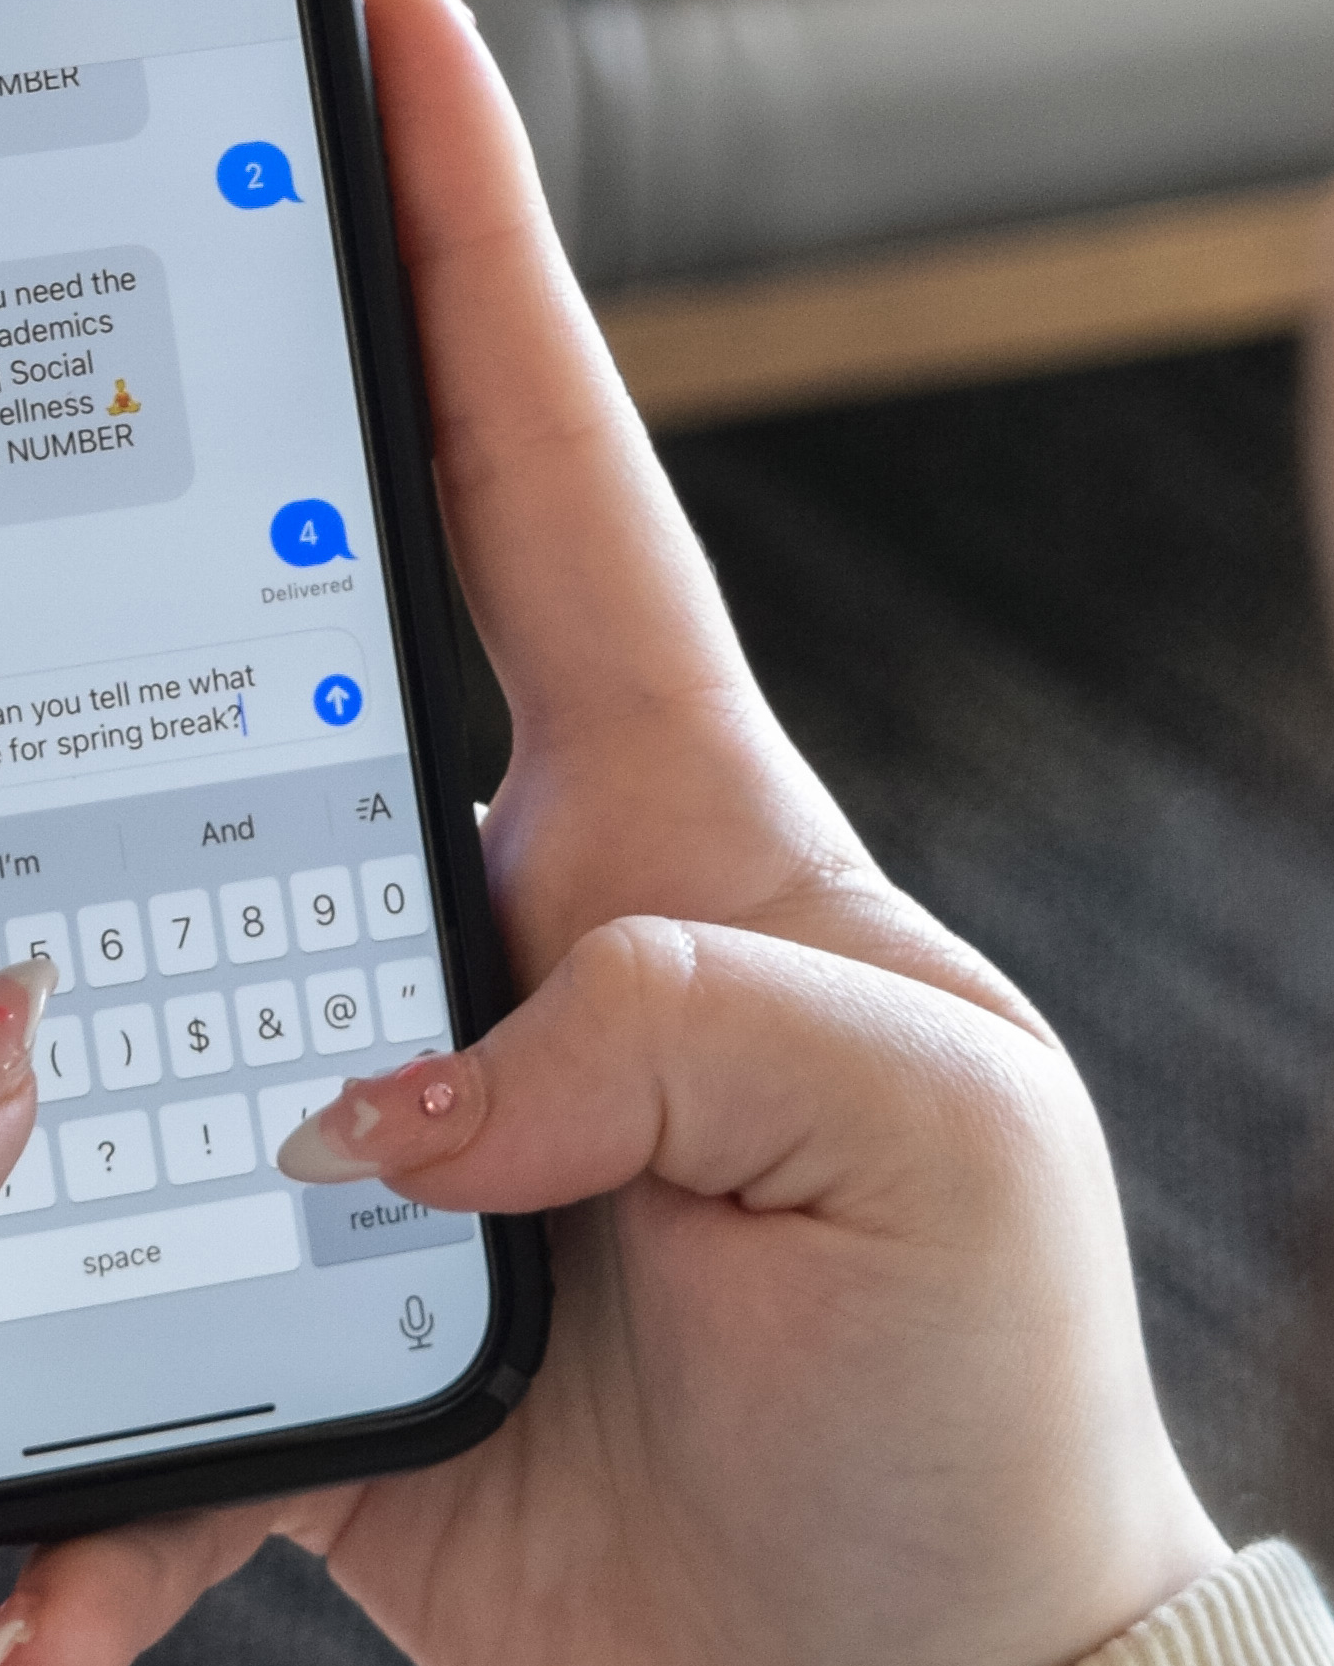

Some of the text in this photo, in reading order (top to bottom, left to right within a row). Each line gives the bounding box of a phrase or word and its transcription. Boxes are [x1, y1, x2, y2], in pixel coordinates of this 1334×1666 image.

[245, 163, 264, 190] 2
[15, 273, 83, 306] need
[91, 269, 136, 295] the
[10, 350, 94, 385] Social
[7, 424, 134, 464] NUMBER
[299, 520, 318, 546] 4
[262, 576, 353, 603] Delivered
[31, 696, 81, 726] you
[89, 681, 130, 710] tell
[139, 680, 180, 703] me
[188, 665, 255, 695] what
[9, 737, 47, 763] for
[57, 724, 143, 759] spring
[150, 704, 242, 740] break?
[202, 814, 255, 846] And
[101, 929, 123, 961] 6
[172, 917, 190, 949] 7
[242, 905, 265, 938] 8
[313, 894, 335, 926] 9
[383, 883, 405, 915] 0
[50, 1041, 62, 1077] (
[121, 1030, 132, 1066] )
[187, 1017, 210, 1053] $
[259, 1008, 284, 1040] &
[324, 994, 357, 1029] @
[97, 1141, 115, 1172] ?
[203, 1124, 211, 1155] !
[351, 1202, 428, 1230] return
[83, 1246, 161, 1277] space
